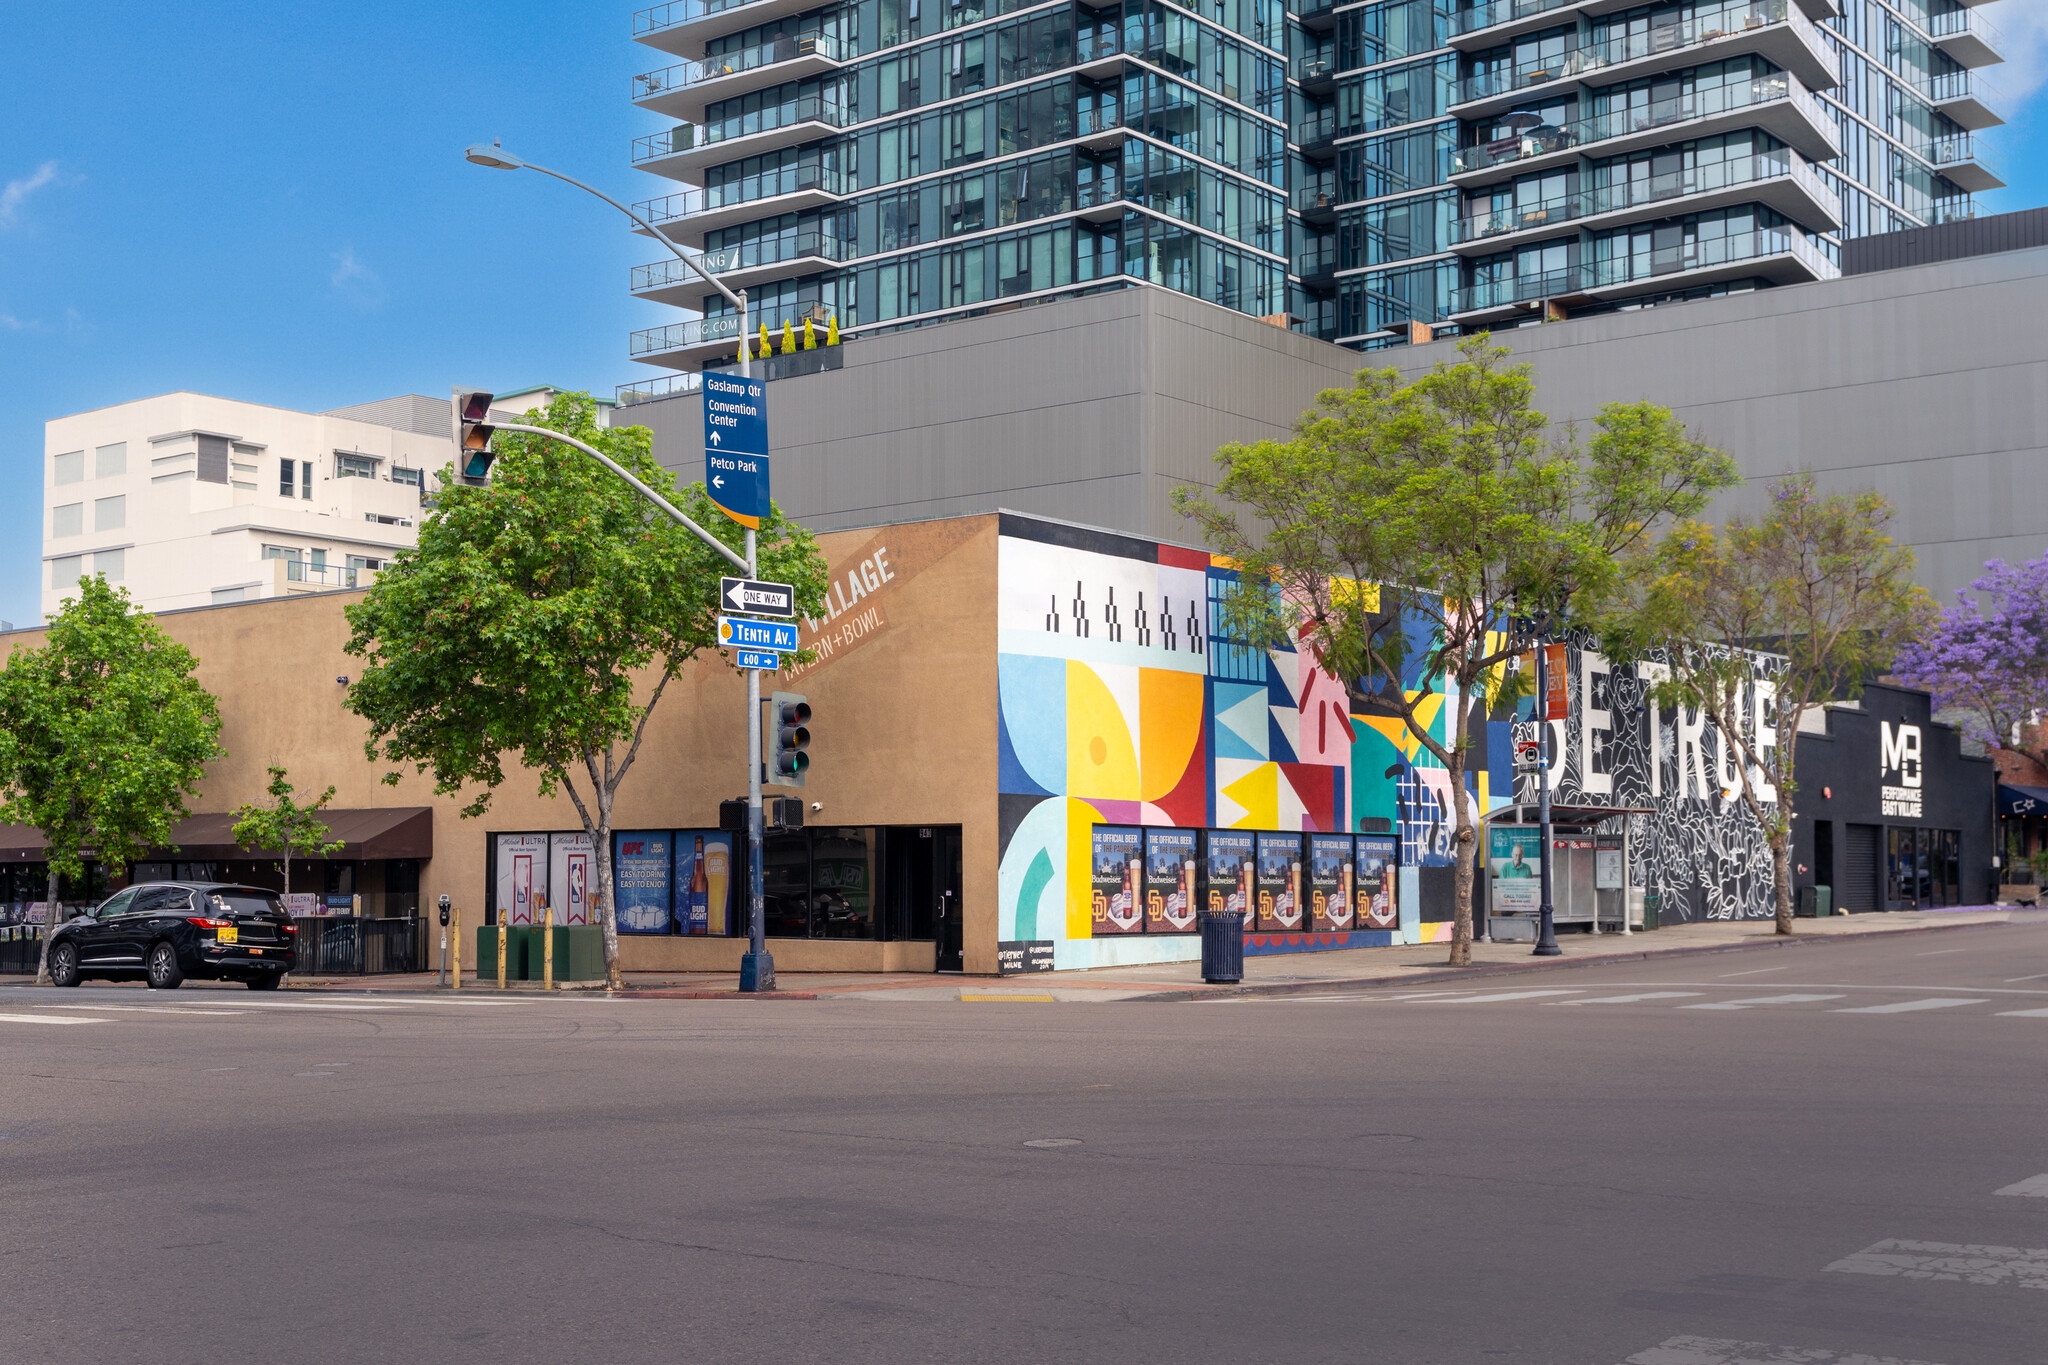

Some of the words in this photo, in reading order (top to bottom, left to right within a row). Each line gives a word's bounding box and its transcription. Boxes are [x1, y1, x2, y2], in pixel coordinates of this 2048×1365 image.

[708, 379, 745, 397] Gaslamp
[748, 385, 761, 397] Qtr
[708, 399, 756, 416] Convention
[709, 414, 737, 427] Center
[710, 457, 734, 470] Petco
[738, 460, 757, 473] Park
[743, 591, 761, 603] ONE
[764, 593, 782, 606] WAY
[737, 624, 770, 643] TENTH
[744, 653, 759, 666] 600
[1548, 675, 1564, 691] EV
[1638, 660, 1778, 803] TRUE
[1882, 786, 1922, 803] PERFORMANCE
[1882, 801, 1898, 816] EAST
[1898, 802, 1922, 818] VILLAGE
[525, 837, 546, 845] ULTRA
[1092, 833, 1102, 843] THE
[1103, 833, 1124, 843] OFFICIAL
[1124, 834, 1138, 844] BEER
[1149, 835, 1158, 844] THE
[1159, 835, 1179, 844] OFFICIAL
[1180, 836, 1192, 845] BEER
[1210, 837, 1219, 846] THE
[1220, 837, 1238, 846] OFFICIAL
[1240, 838, 1250, 847] BEER
[1260, 838, 1268, 847] THE
[1269, 839, 1286, 847] OFFICIAL
[1288, 839, 1298, 847] BEER
[1322, 841, 1339, 849] OFFICIAL
[1340, 841, 1350, 849] BEER
[622, 842, 645, 855] UFC
[1095, 844, 1101, 853] OF
[1103, 844, 1112, 853] THE
[1152, 846, 1158, 854] OF
[1212, 848, 1218, 856] OF
[1366, 842, 1382, 850] OFFICIAL
[1383, 842, 1392, 850] BEER
[1316, 850, 1321, 858] OF
[710, 858, 723, 866] BUD
[1092, 875, 1121, 883] Budweiser
[1148, 875, 1176, 884] Budweiser
[1148, 889, 1163, 922] SD
[1260, 890, 1272, 920] SD
[1313, 890, 1326, 919] SD
[1357, 890, 1370, 919] SD
[690, 912, 707, 920] LIGHT
